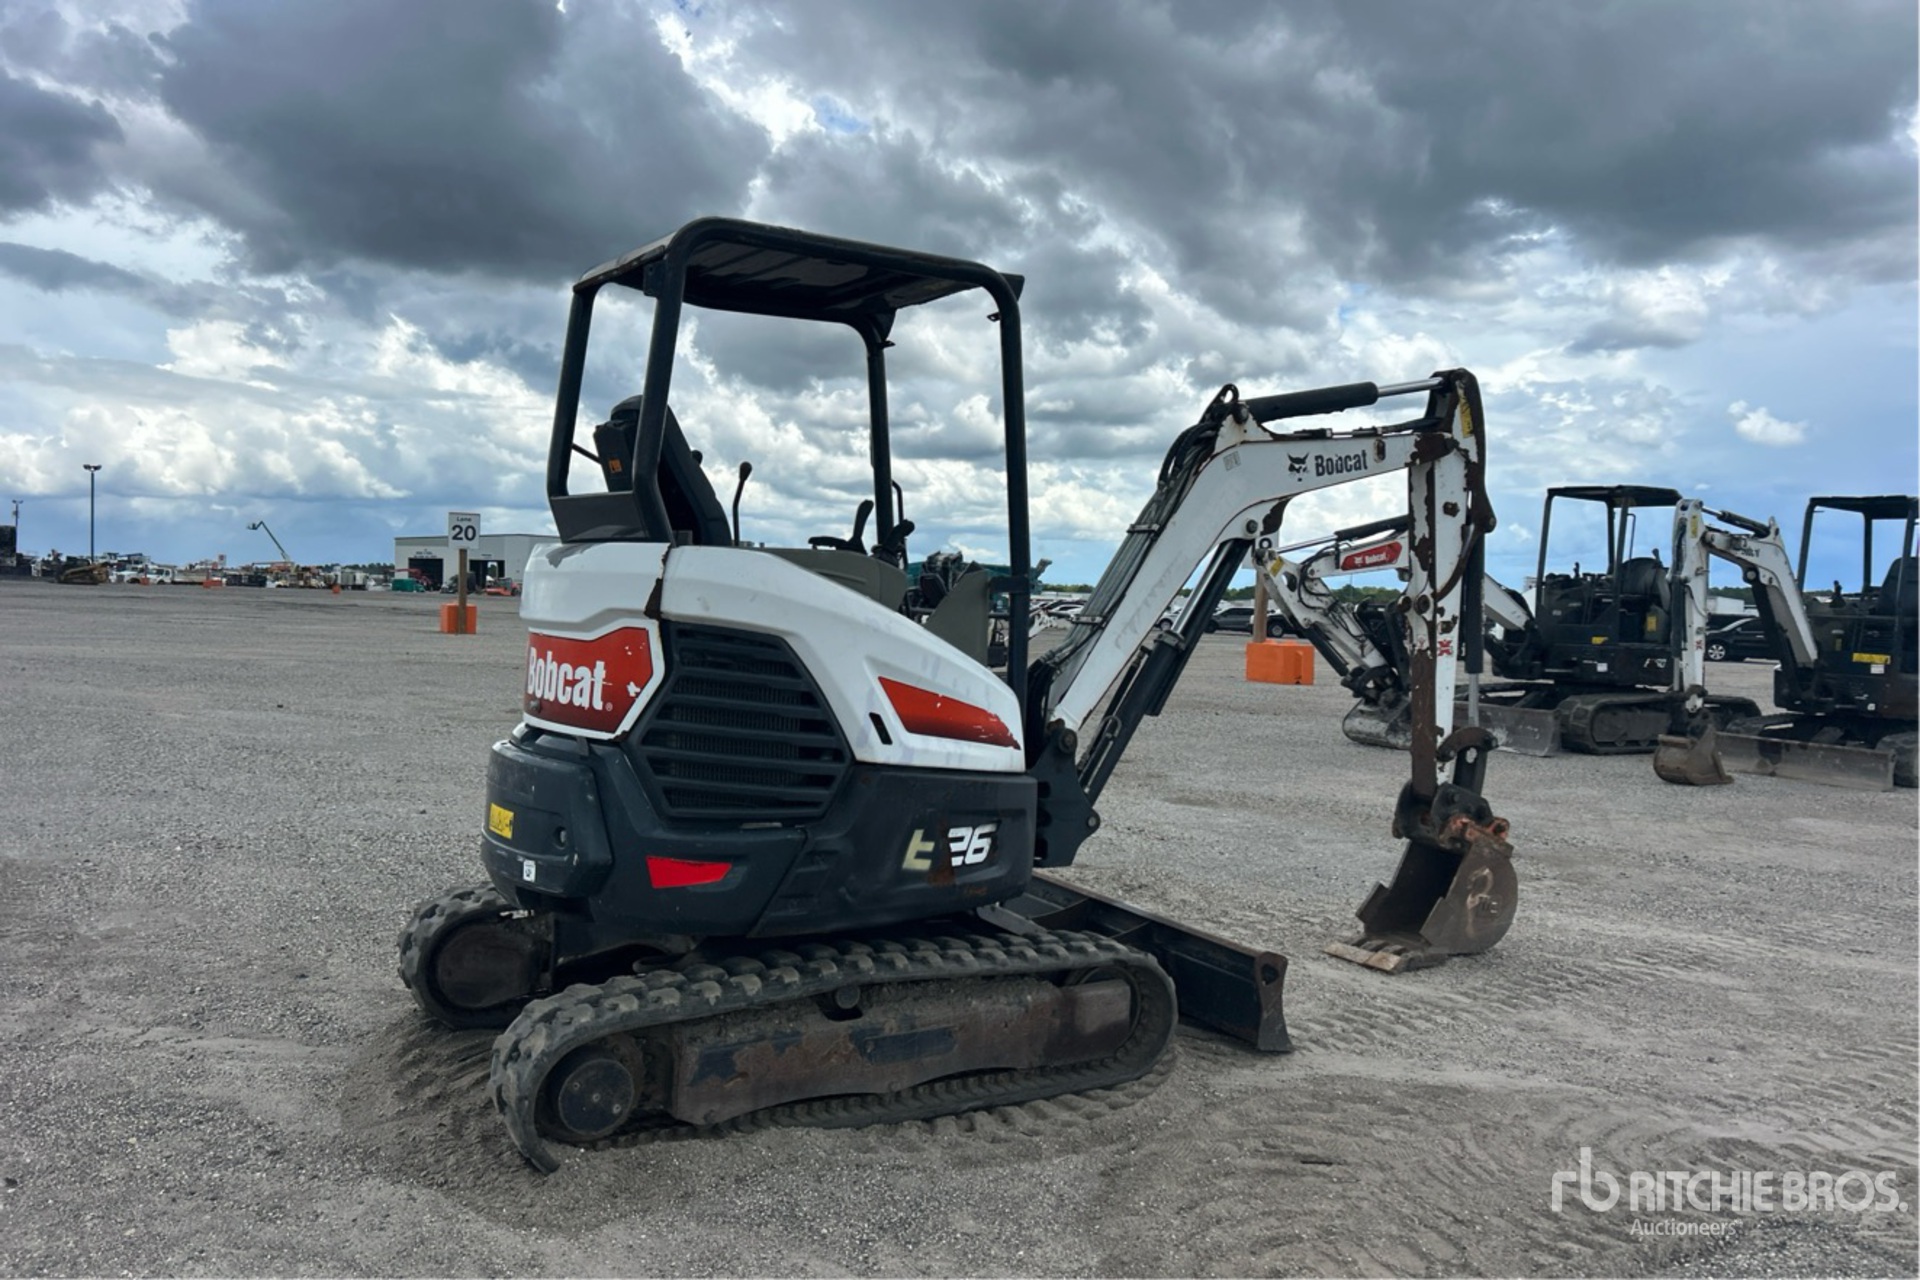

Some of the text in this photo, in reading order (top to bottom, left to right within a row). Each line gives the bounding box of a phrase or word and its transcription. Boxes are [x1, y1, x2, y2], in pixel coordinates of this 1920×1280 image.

[1314, 449, 1368, 477] Bobcat
[451, 524, 477, 541] 20
[527, 646, 606, 711] Bobcat
